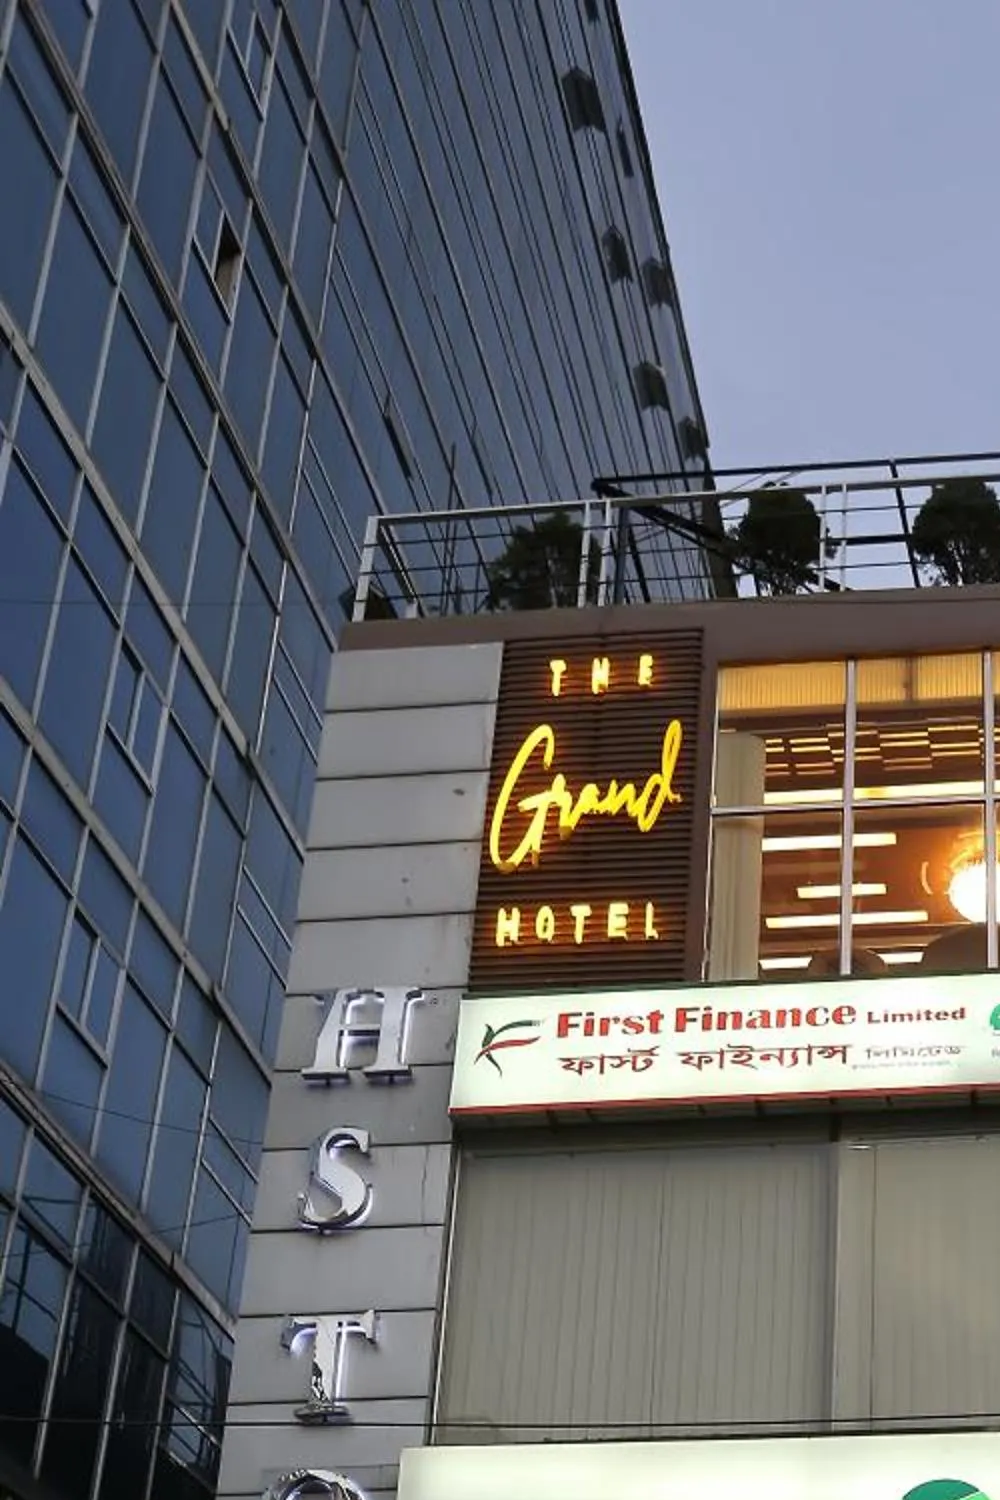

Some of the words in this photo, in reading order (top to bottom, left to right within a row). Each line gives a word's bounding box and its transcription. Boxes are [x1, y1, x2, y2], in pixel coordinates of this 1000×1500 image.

[549, 653, 654, 696] THE
[489, 719, 683, 873] Grand
[495, 901, 659, 947] HOTEL
[557, 1009, 665, 1038] First
[674, 1003, 856, 1033] Finance
[867, 1006, 966, 1025] Limited
